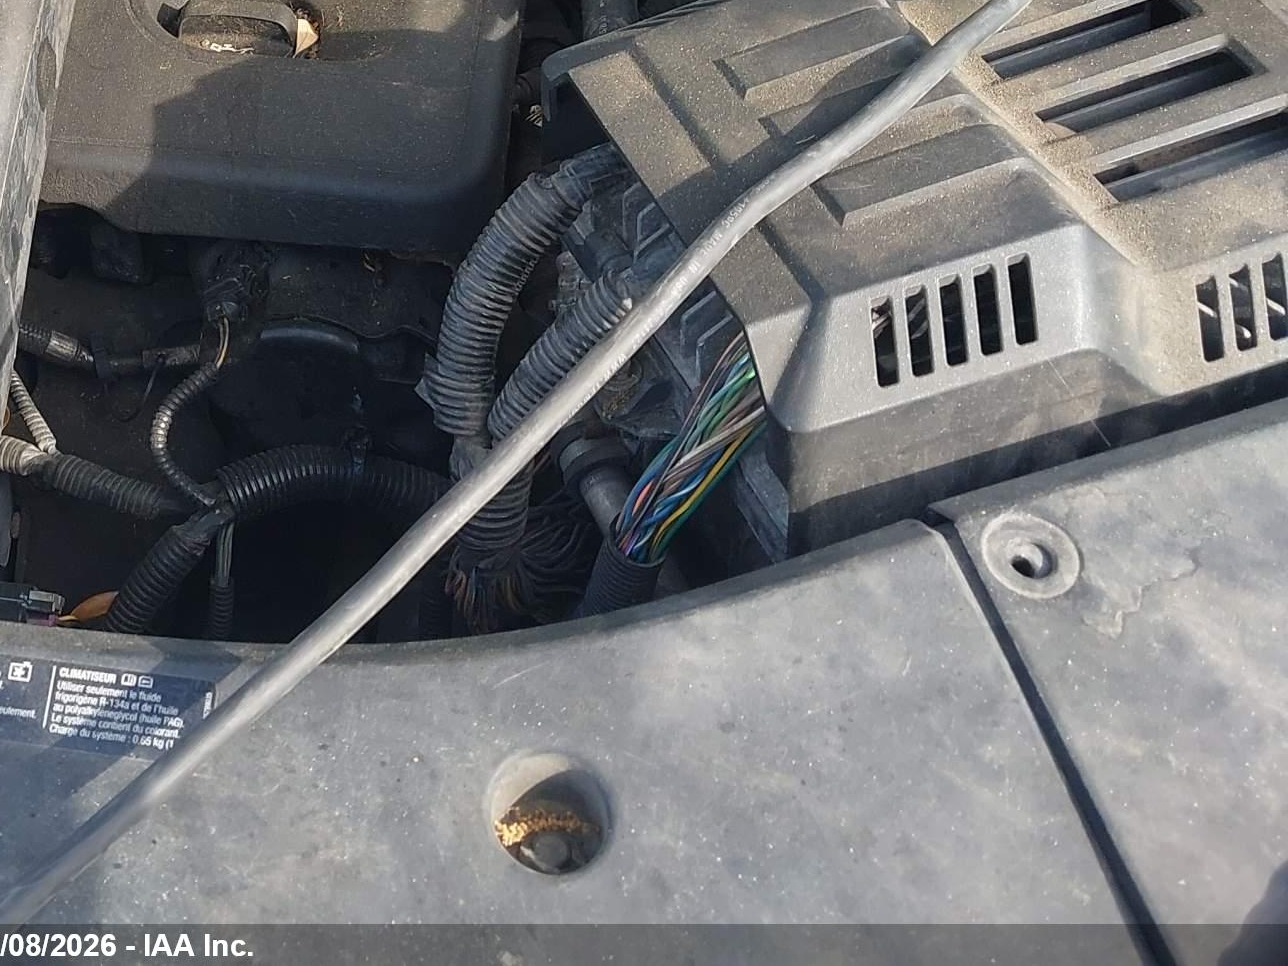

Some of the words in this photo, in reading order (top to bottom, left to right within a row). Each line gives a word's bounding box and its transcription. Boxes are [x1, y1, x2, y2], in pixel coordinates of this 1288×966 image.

[58, 666, 116, 683] CLIMATISEUR
[56, 680, 86, 692] Utiliser
[86, 684, 128, 697] seulement
[128, 690, 138, 698] le
[138, 691, 162, 702] fluide
[52, 702, 64, 712] au
[98, 697, 130, 709] R-134a
[130, 701, 140, 710] et
[140, 702, 152, 712] de
[51, 714, 62, 722] Le
[62, 715, 97, 728] système
[98, 720, 131, 731] contient
[132, 724, 144, 733] du
[48, 724, 78, 737] Charge
[78, 728, 91, 737] du
[92, 729, 126, 743] système
[152, 737, 164, 748] kg
